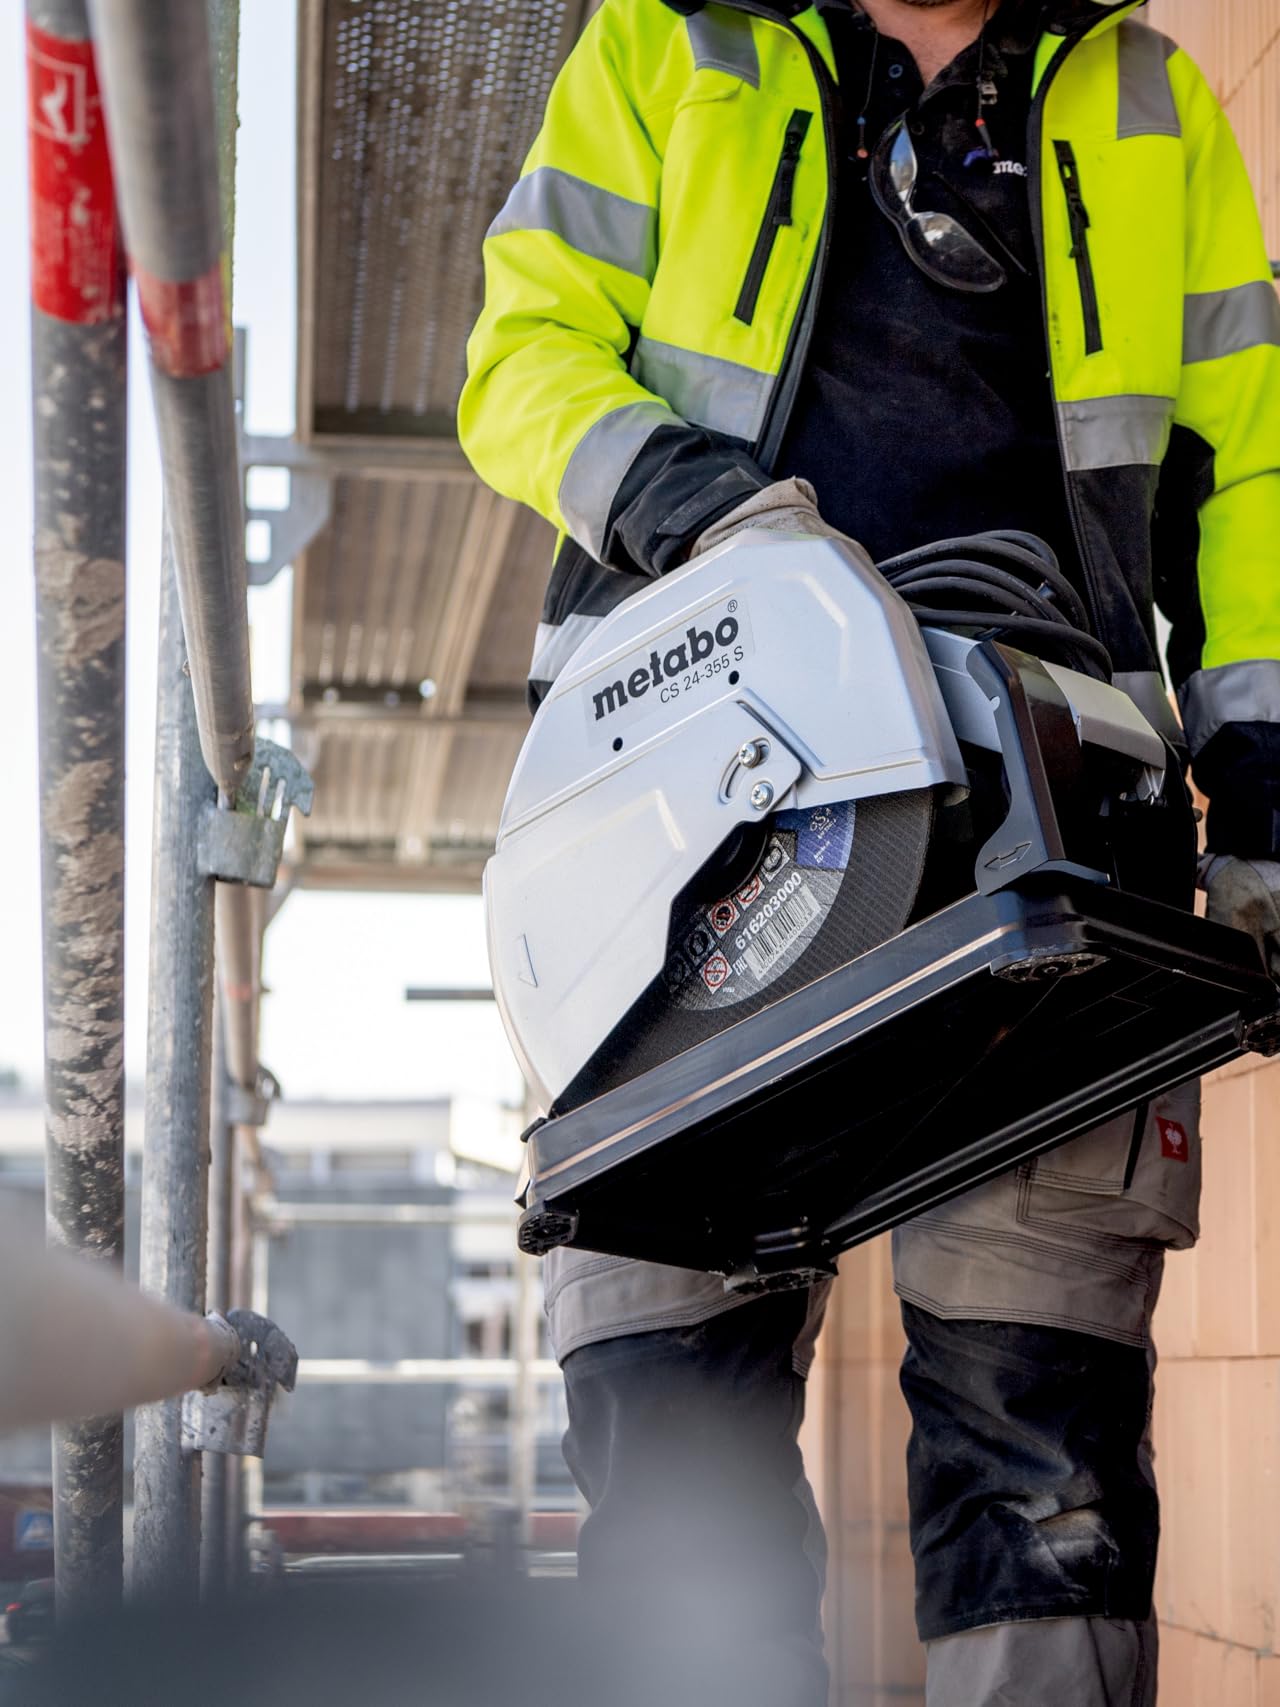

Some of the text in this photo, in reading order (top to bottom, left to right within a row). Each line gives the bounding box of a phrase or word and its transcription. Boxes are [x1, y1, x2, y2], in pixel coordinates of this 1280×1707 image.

[592, 616, 739, 721] metabo
[660, 645, 744, 704] CS 24-355 S
[735, 871, 801, 950] 616203000
